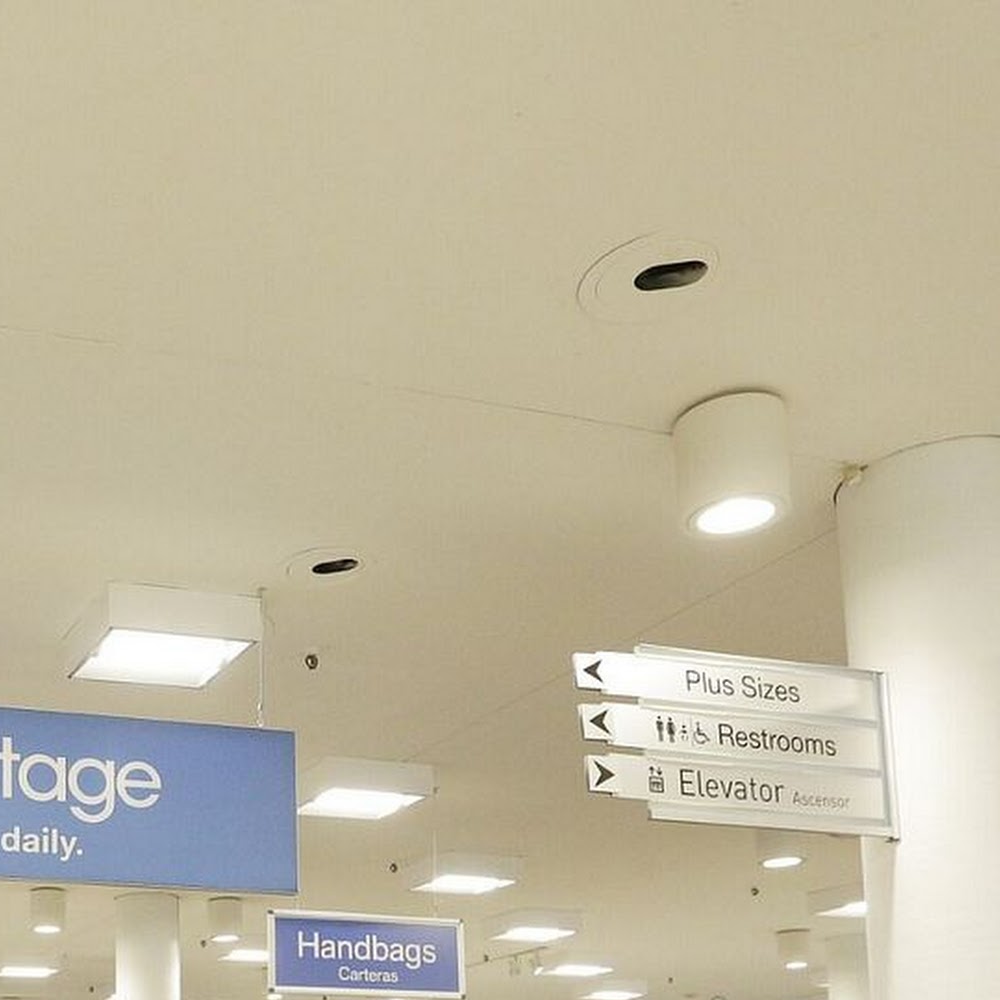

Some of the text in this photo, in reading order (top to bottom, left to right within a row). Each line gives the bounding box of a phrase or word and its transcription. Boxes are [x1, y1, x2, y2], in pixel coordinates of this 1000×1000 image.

[685, 669, 800, 703] Plus Sizes
[718, 723, 837, 756] Restrooms
[679, 768, 850, 809] Elevator Ascensor
[1, 826, 83, 861] daily.
[297, 930, 437, 970] Handbags
[338, 965, 398, 983] Carteras
